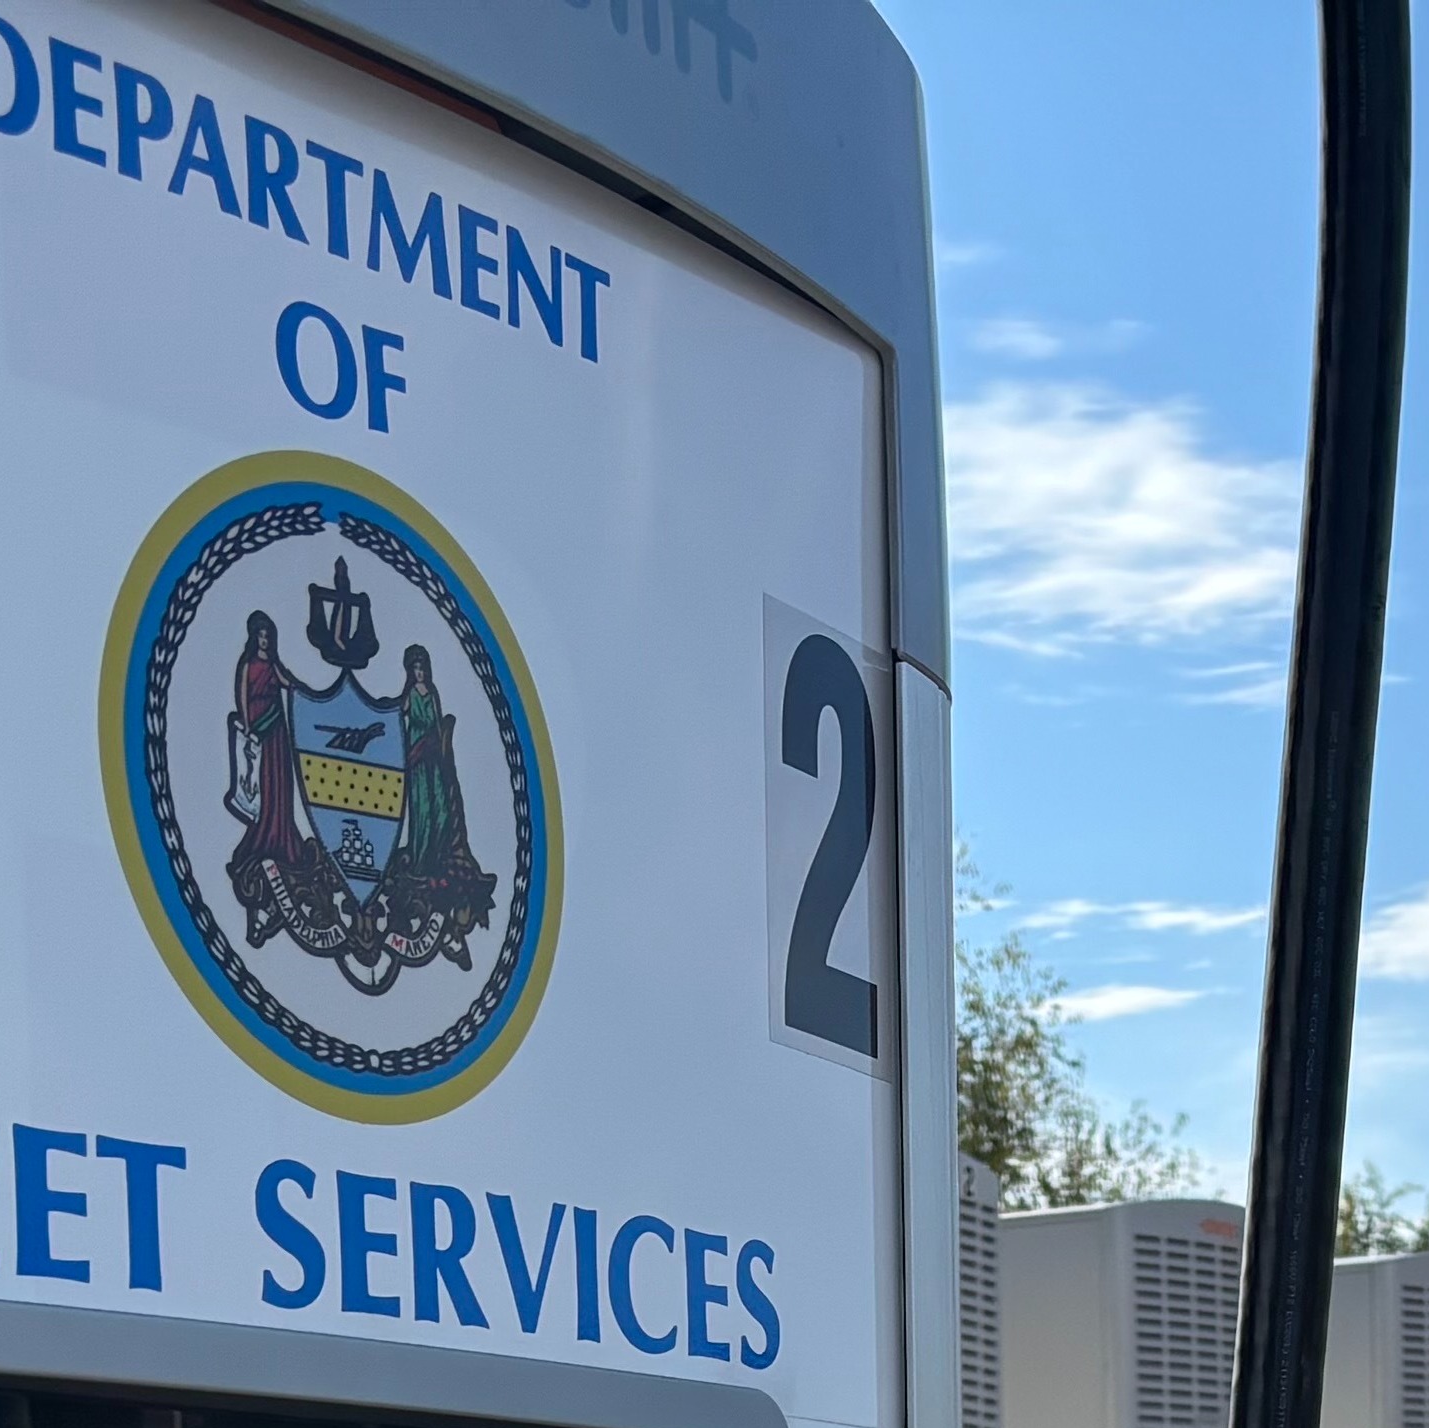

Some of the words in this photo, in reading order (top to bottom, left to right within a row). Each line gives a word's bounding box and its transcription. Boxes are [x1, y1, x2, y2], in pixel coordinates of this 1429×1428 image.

[275, 301, 407, 434] OF
[782, 634, 879, 1060] 2
[255, 1159, 781, 1370] SERVICES
